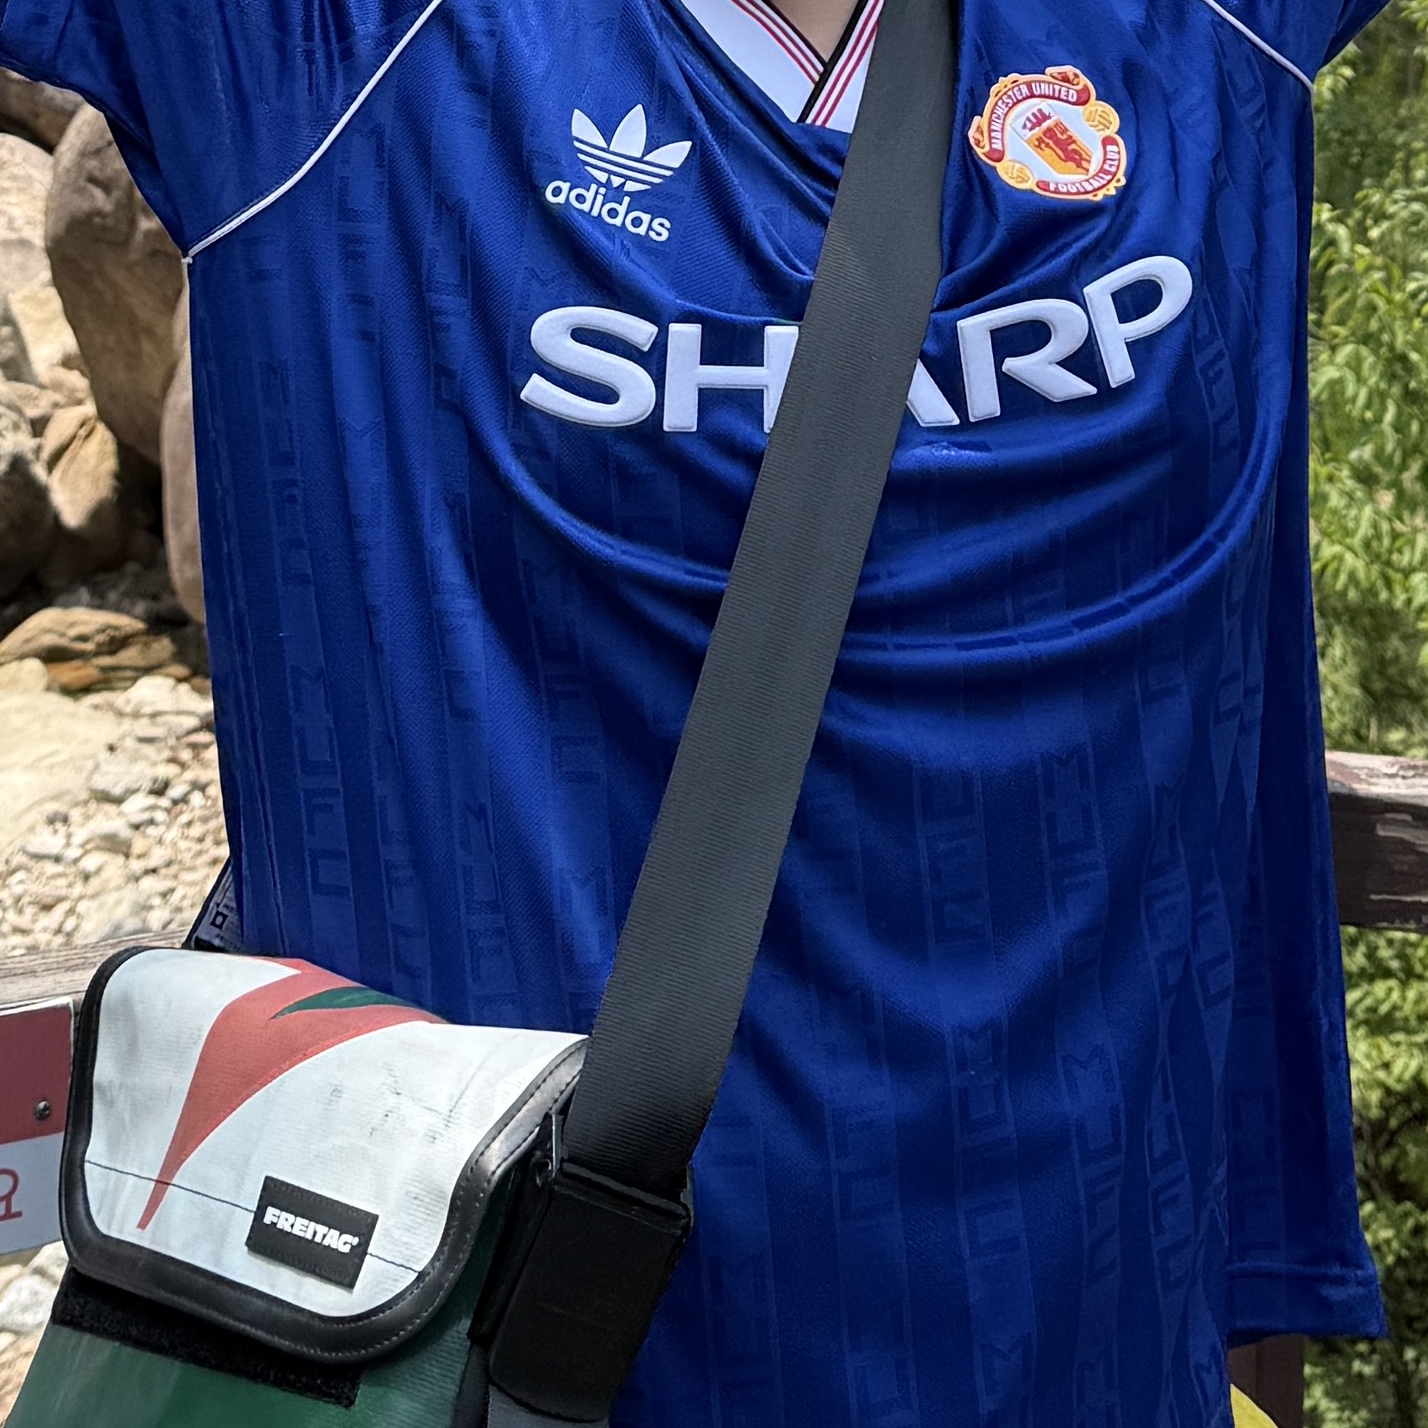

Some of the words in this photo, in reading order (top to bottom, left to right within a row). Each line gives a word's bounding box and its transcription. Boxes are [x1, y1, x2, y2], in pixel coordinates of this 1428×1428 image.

[990, 83, 1031, 151] MANCHESTER
[1031, 81, 1078, 103] UNITED
[1048, 172, 1113, 193] FOOTBALL
[1103, 144, 1120, 172] CLUB
[544, 180, 672, 242] adidas
